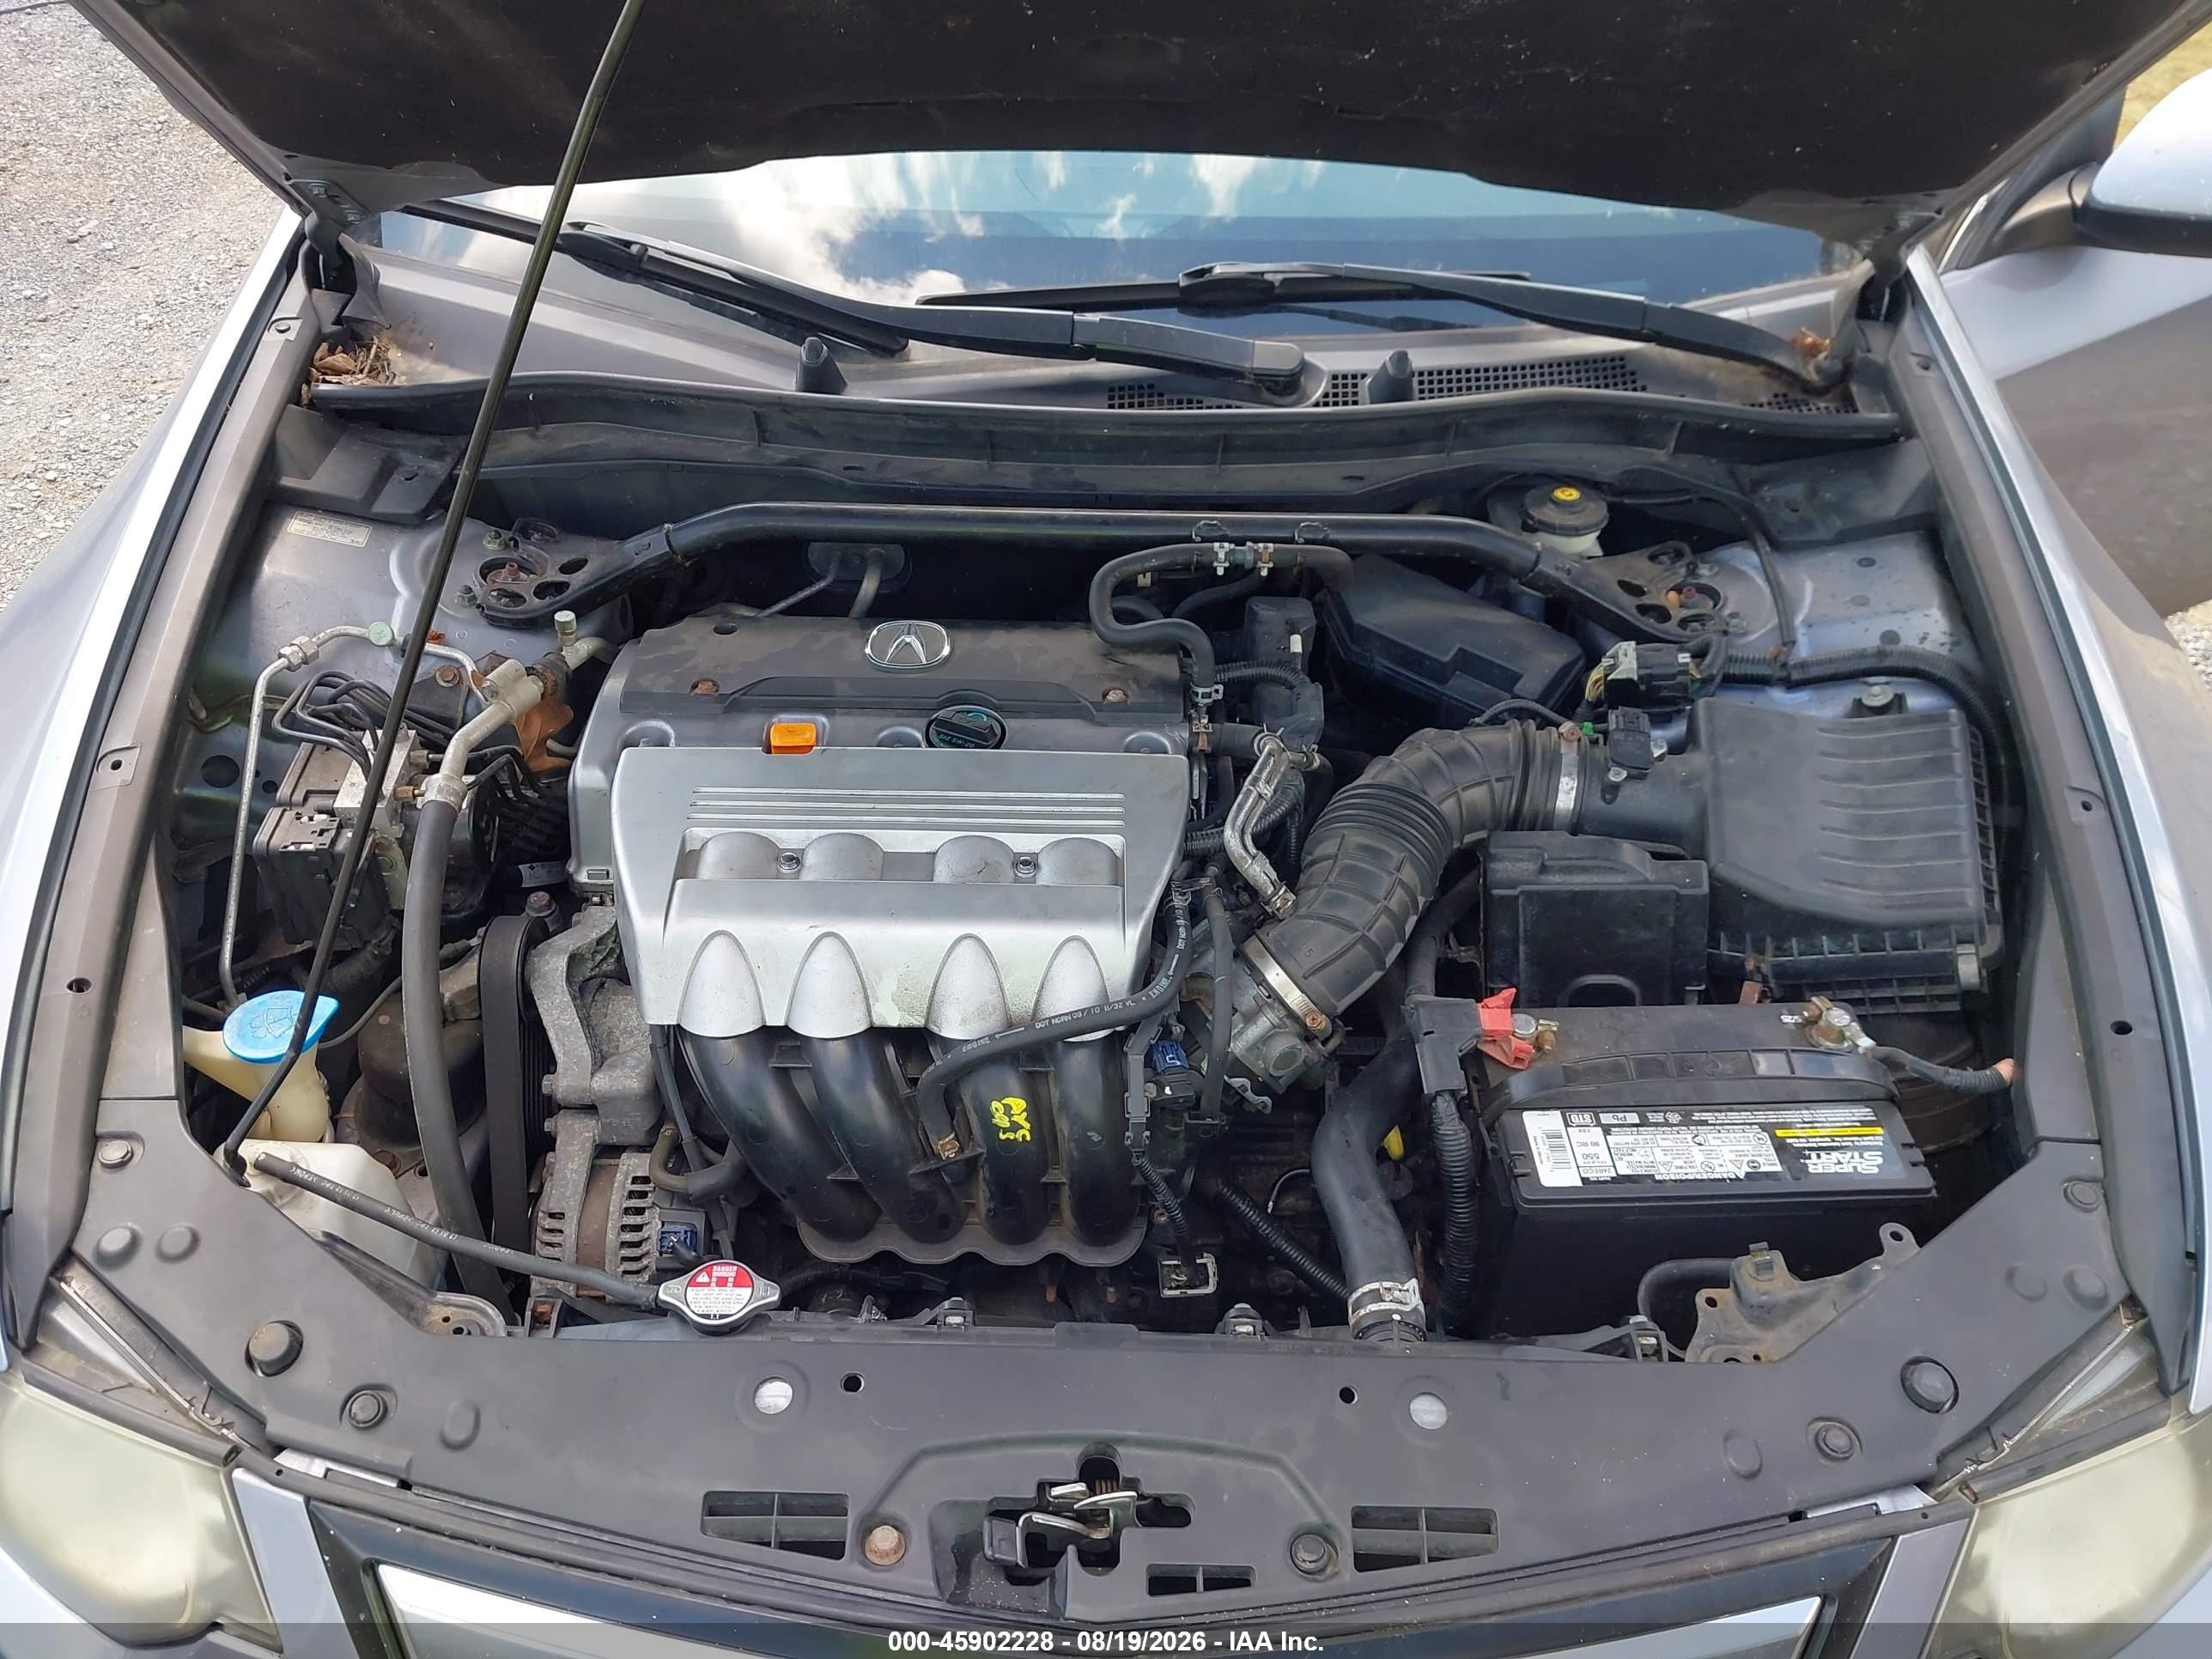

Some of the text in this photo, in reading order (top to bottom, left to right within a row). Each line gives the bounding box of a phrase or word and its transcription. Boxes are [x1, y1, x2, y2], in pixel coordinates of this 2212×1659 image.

[1035, 1020, 1049, 1029] DOT
[1807, 1151, 1883, 1164] START
[1808, 1163, 1879, 1174] SUPER
